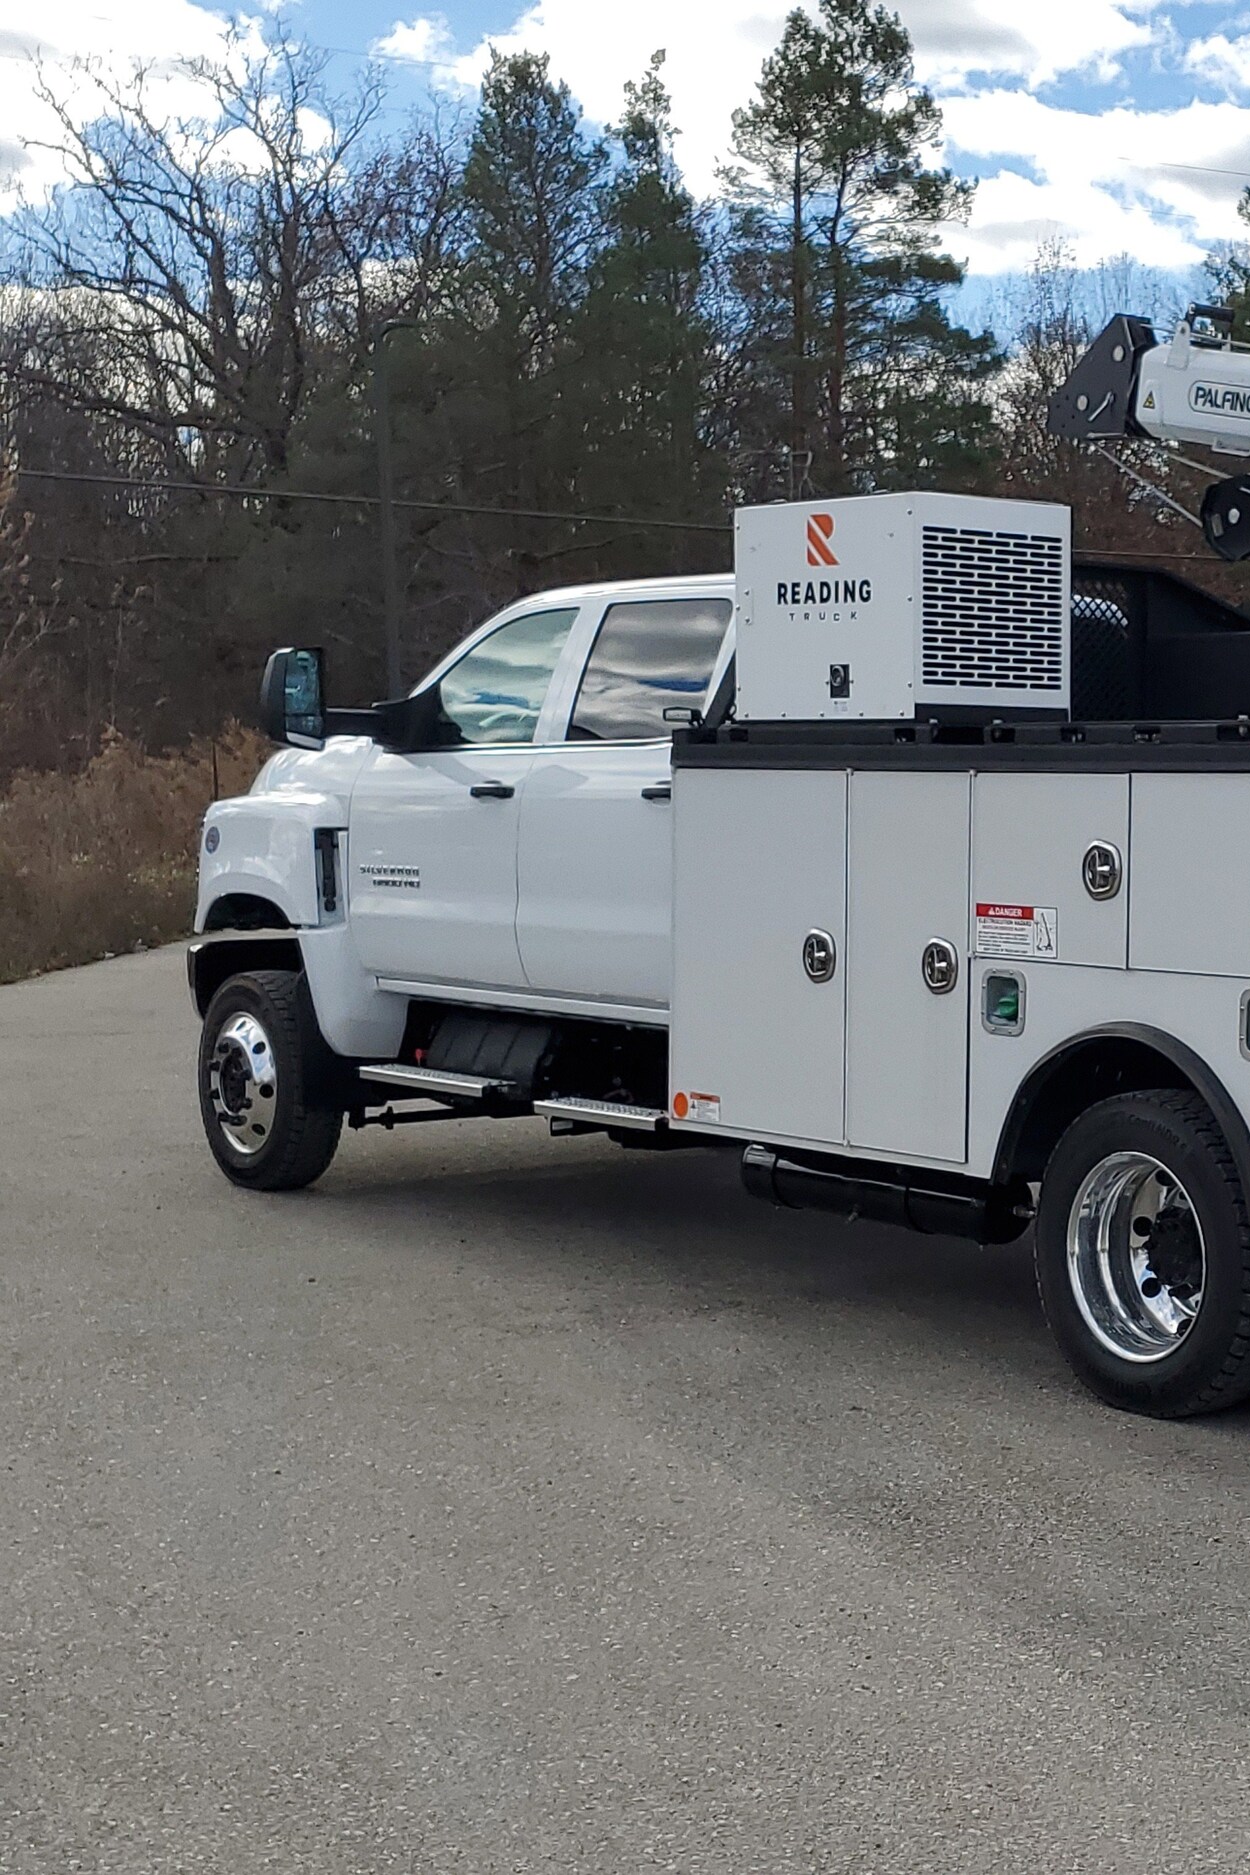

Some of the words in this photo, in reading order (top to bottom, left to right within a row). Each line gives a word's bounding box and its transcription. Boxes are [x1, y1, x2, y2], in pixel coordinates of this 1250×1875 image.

[777, 579, 872, 605] READING
[789, 611, 858, 622] TRUCK
[995, 907, 1022, 917] DANGER
